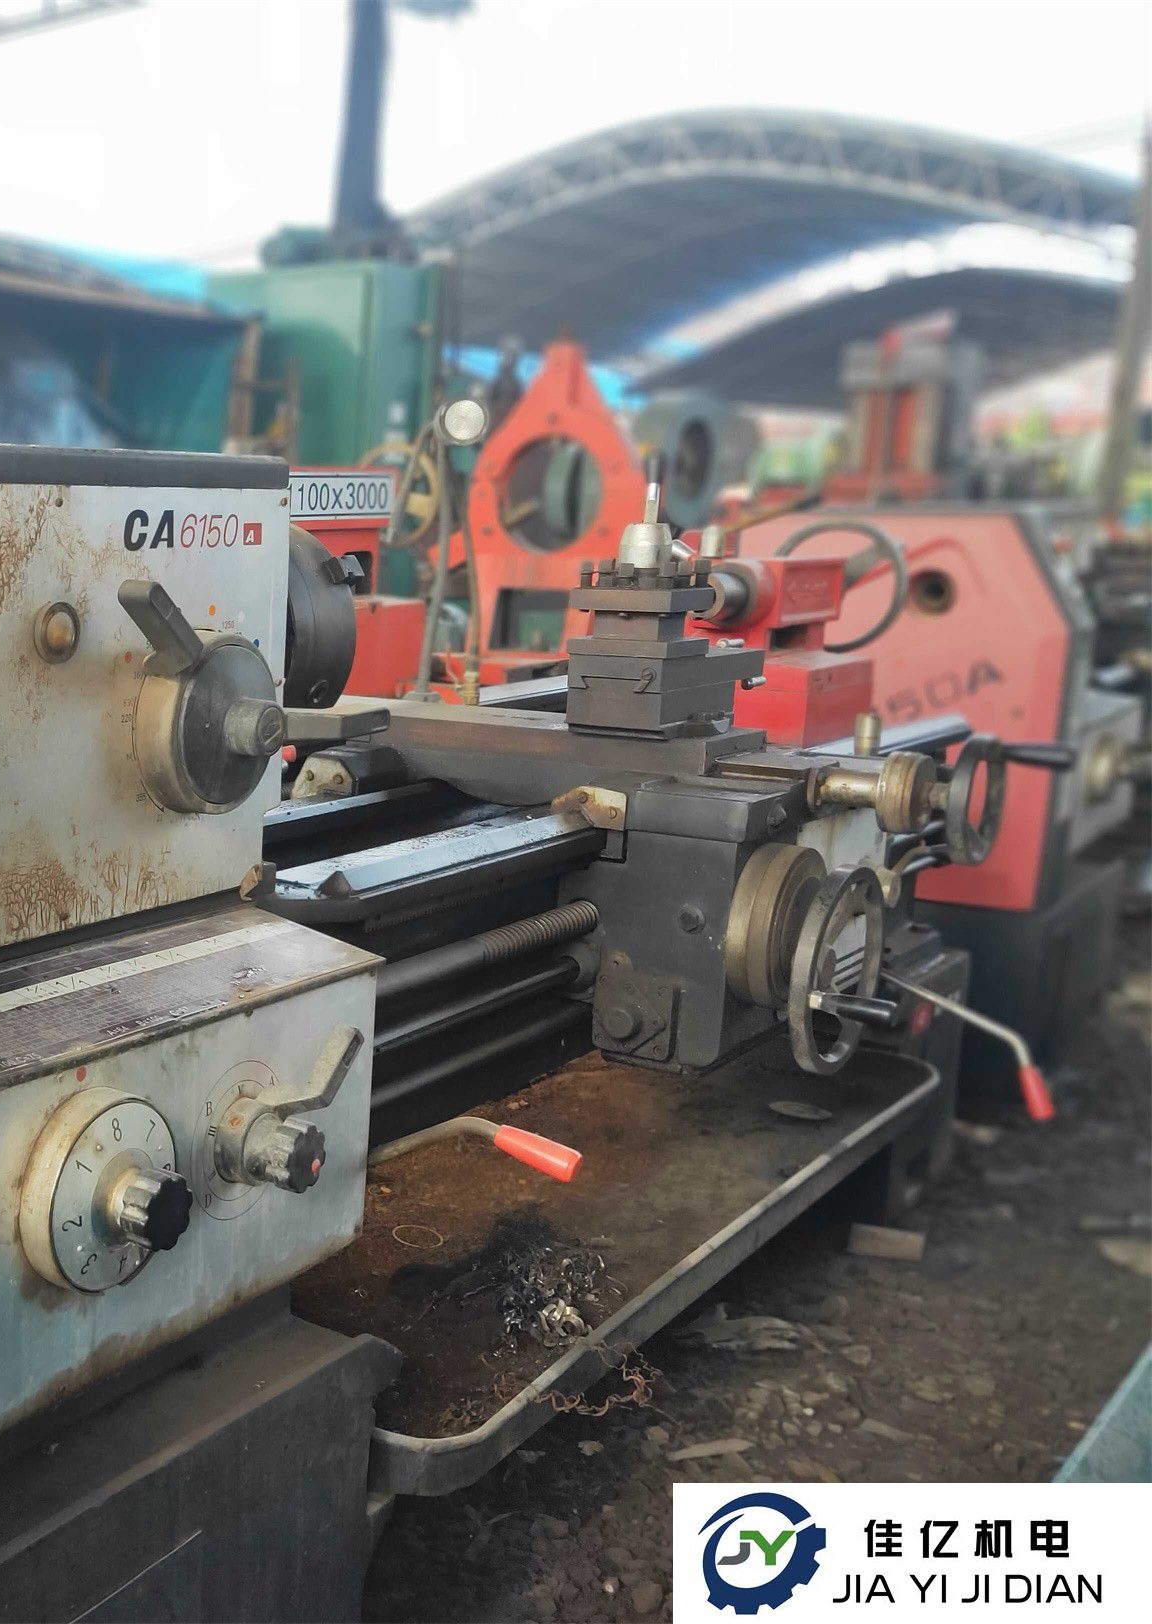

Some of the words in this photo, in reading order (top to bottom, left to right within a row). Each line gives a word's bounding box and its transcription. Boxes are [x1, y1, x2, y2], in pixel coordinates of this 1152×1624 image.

[111, 1118, 122, 1142] 8
[146, 1119, 156, 1142] 7
[75, 1159, 93, 1174] 1
[61, 1215, 83, 1232] 2
[80, 1253, 97, 1275] 3
